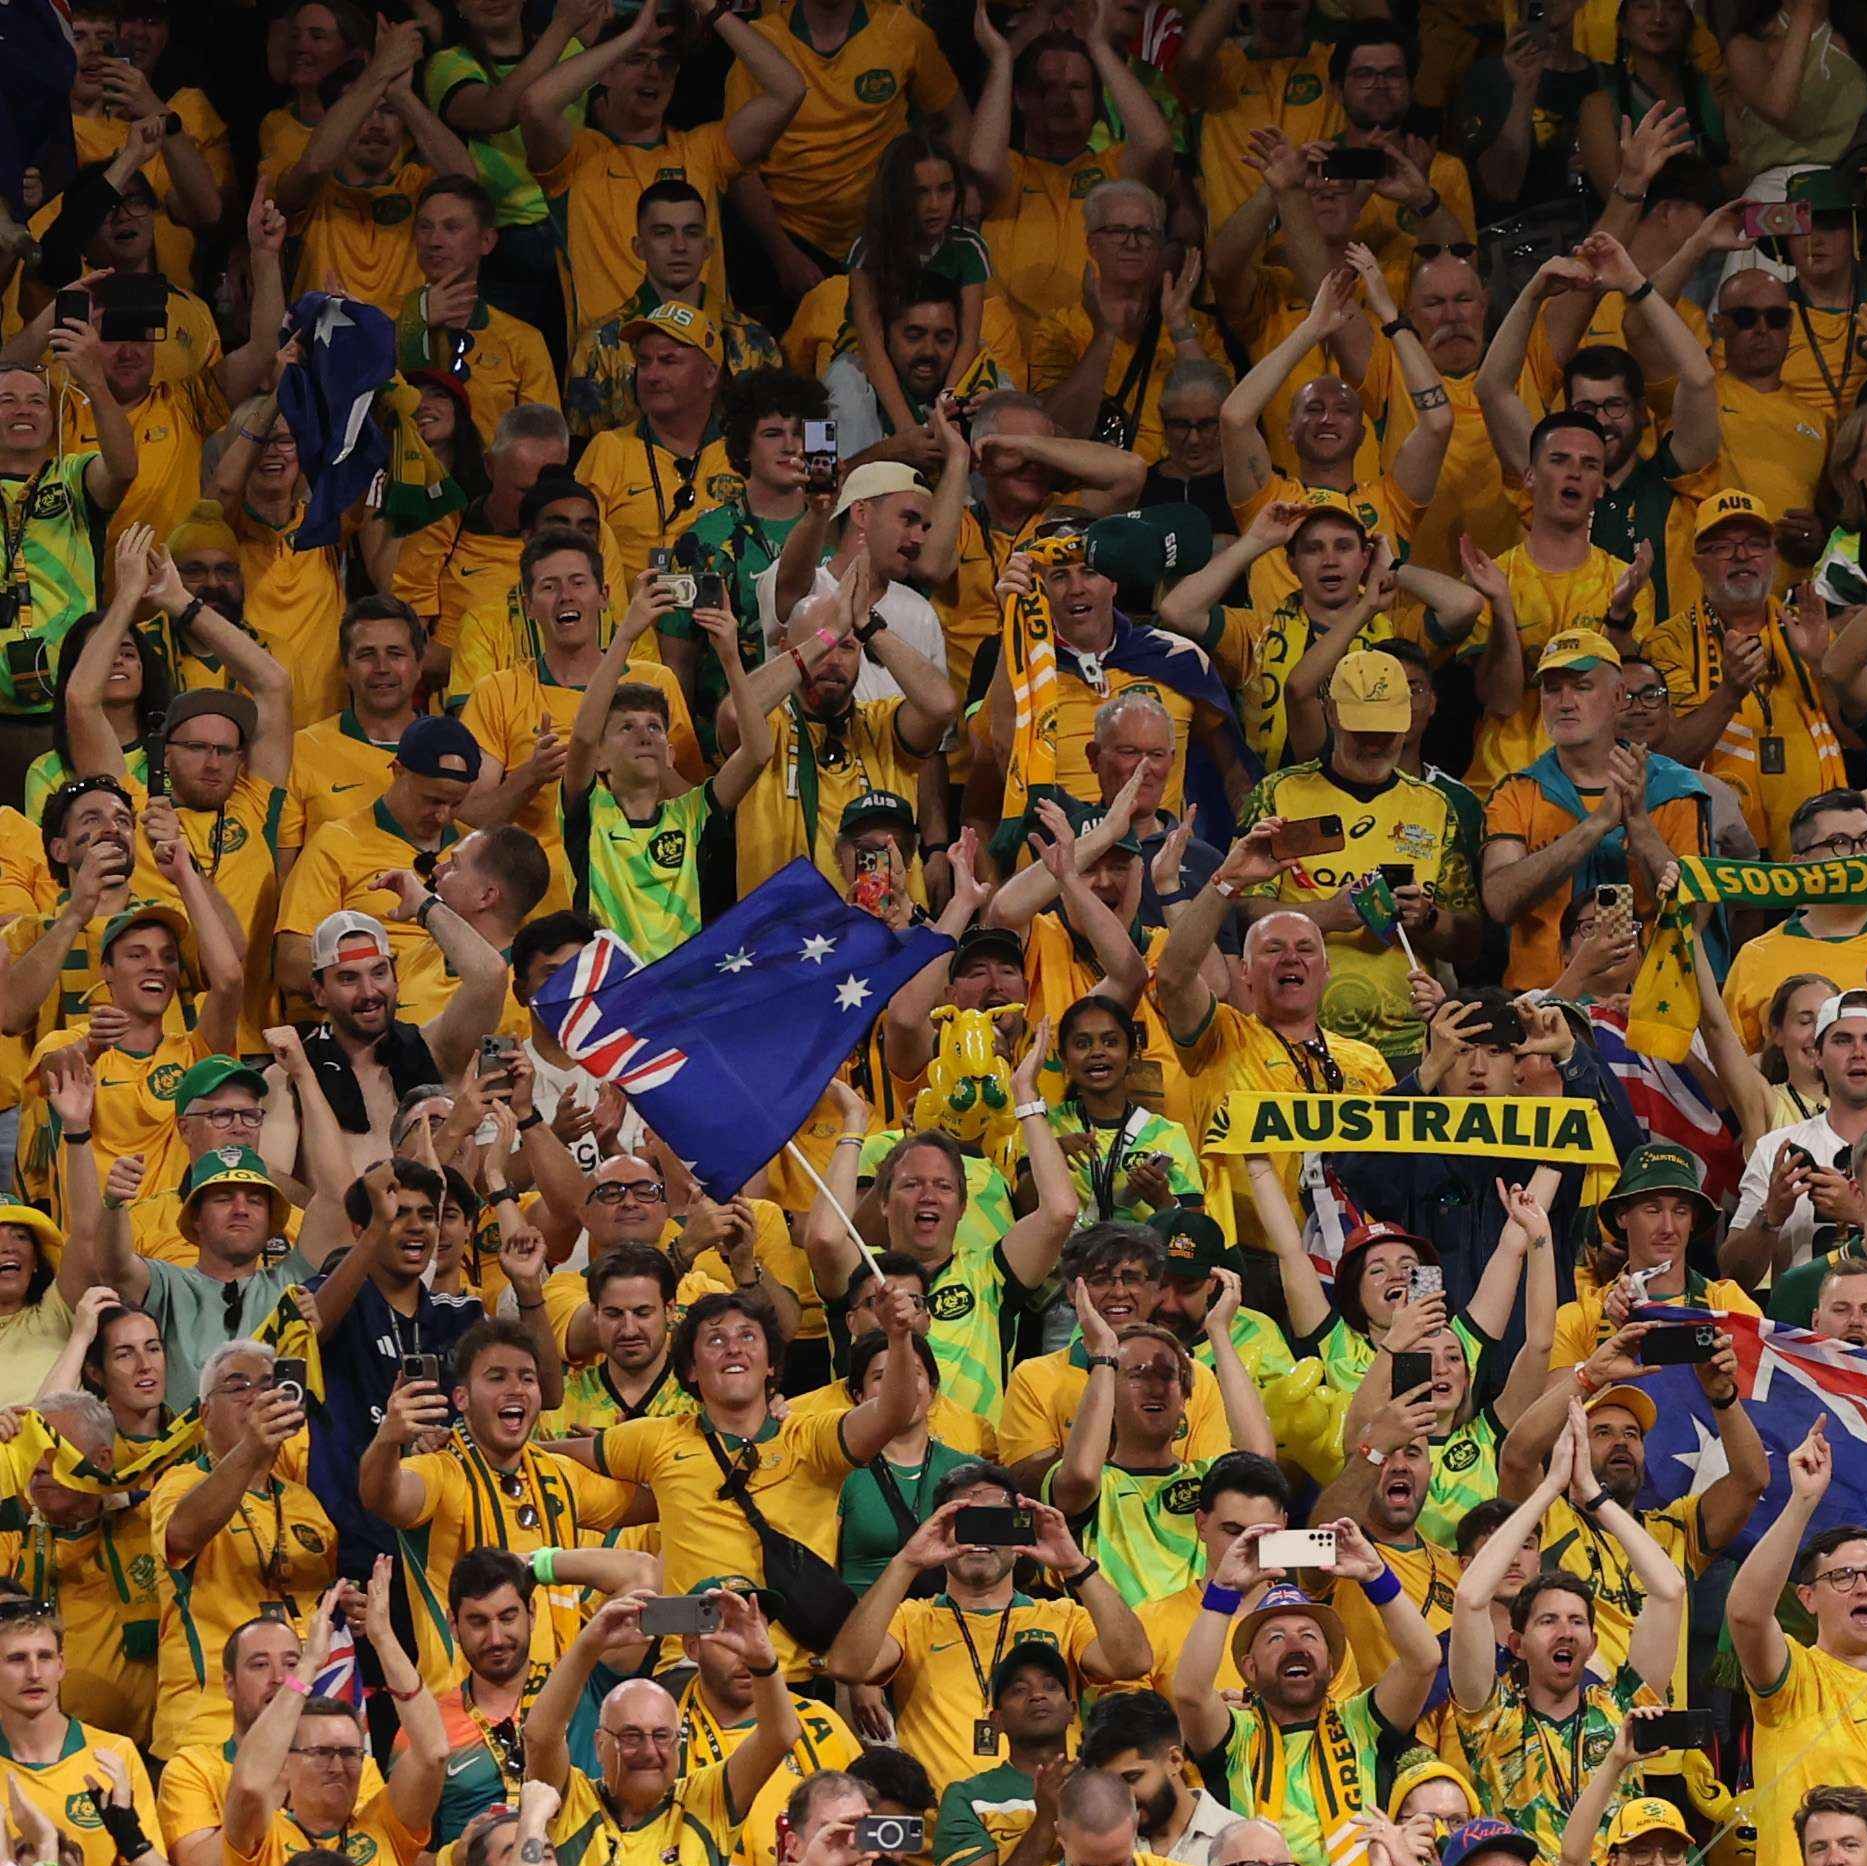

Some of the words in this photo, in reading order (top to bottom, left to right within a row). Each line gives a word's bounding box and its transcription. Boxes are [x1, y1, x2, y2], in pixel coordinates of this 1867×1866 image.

[1717, 496, 1754, 513] AUS
[860, 793, 898, 810] AUS
[1251, 1101, 1592, 1151] AUSTRALIA
